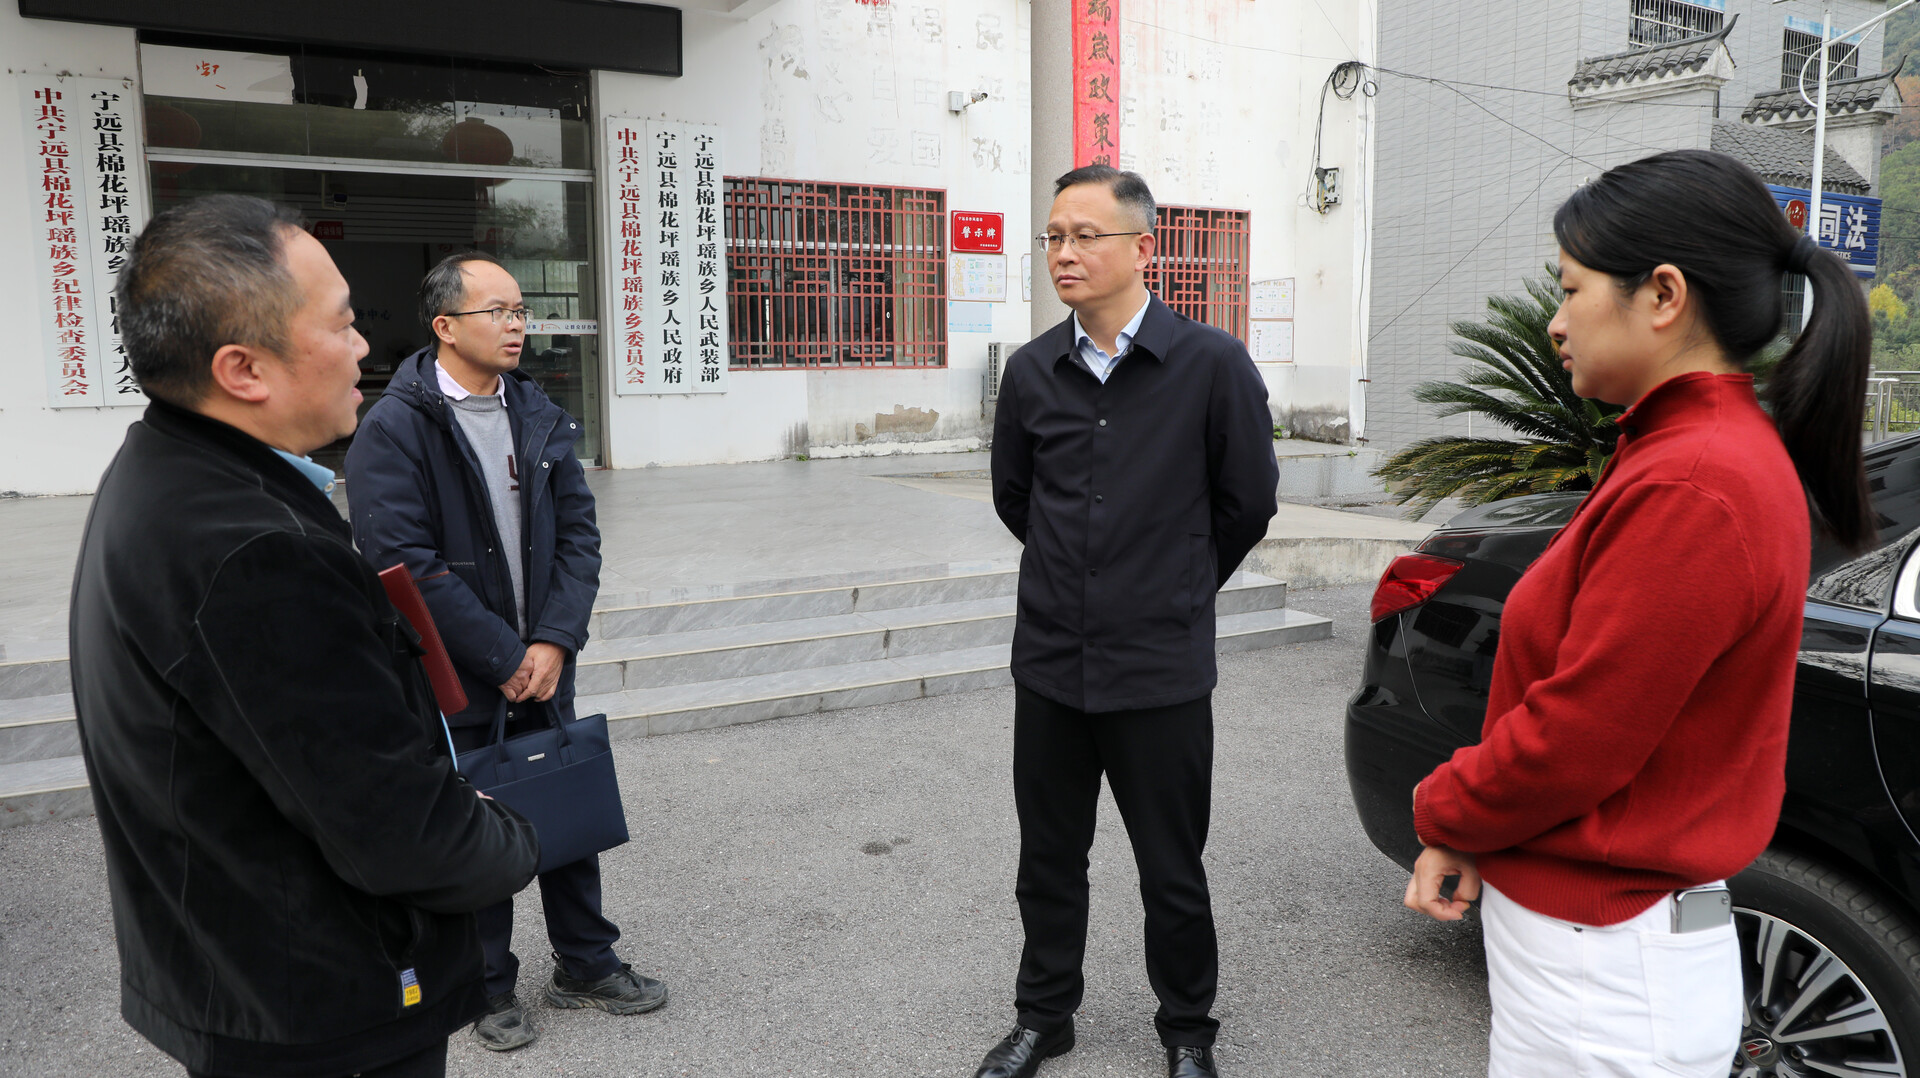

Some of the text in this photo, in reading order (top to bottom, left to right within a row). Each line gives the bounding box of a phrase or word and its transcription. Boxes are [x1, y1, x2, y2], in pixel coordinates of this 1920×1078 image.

[34, 88, 90, 396] 中共宁远县棉花坪瑶族乡纪律检查委员会
[617, 128, 646, 384] 中共宁远县棉花坪瑶族乡委员会
[656, 131, 683, 384] 宁远县棉花坪瑶族乡人民政府
[694, 135, 720, 383] 宁远县棉花坪瑶族乡人民武装部
[961, 226, 996, 240] 警示牌
[1820, 203, 1868, 251] 司法
